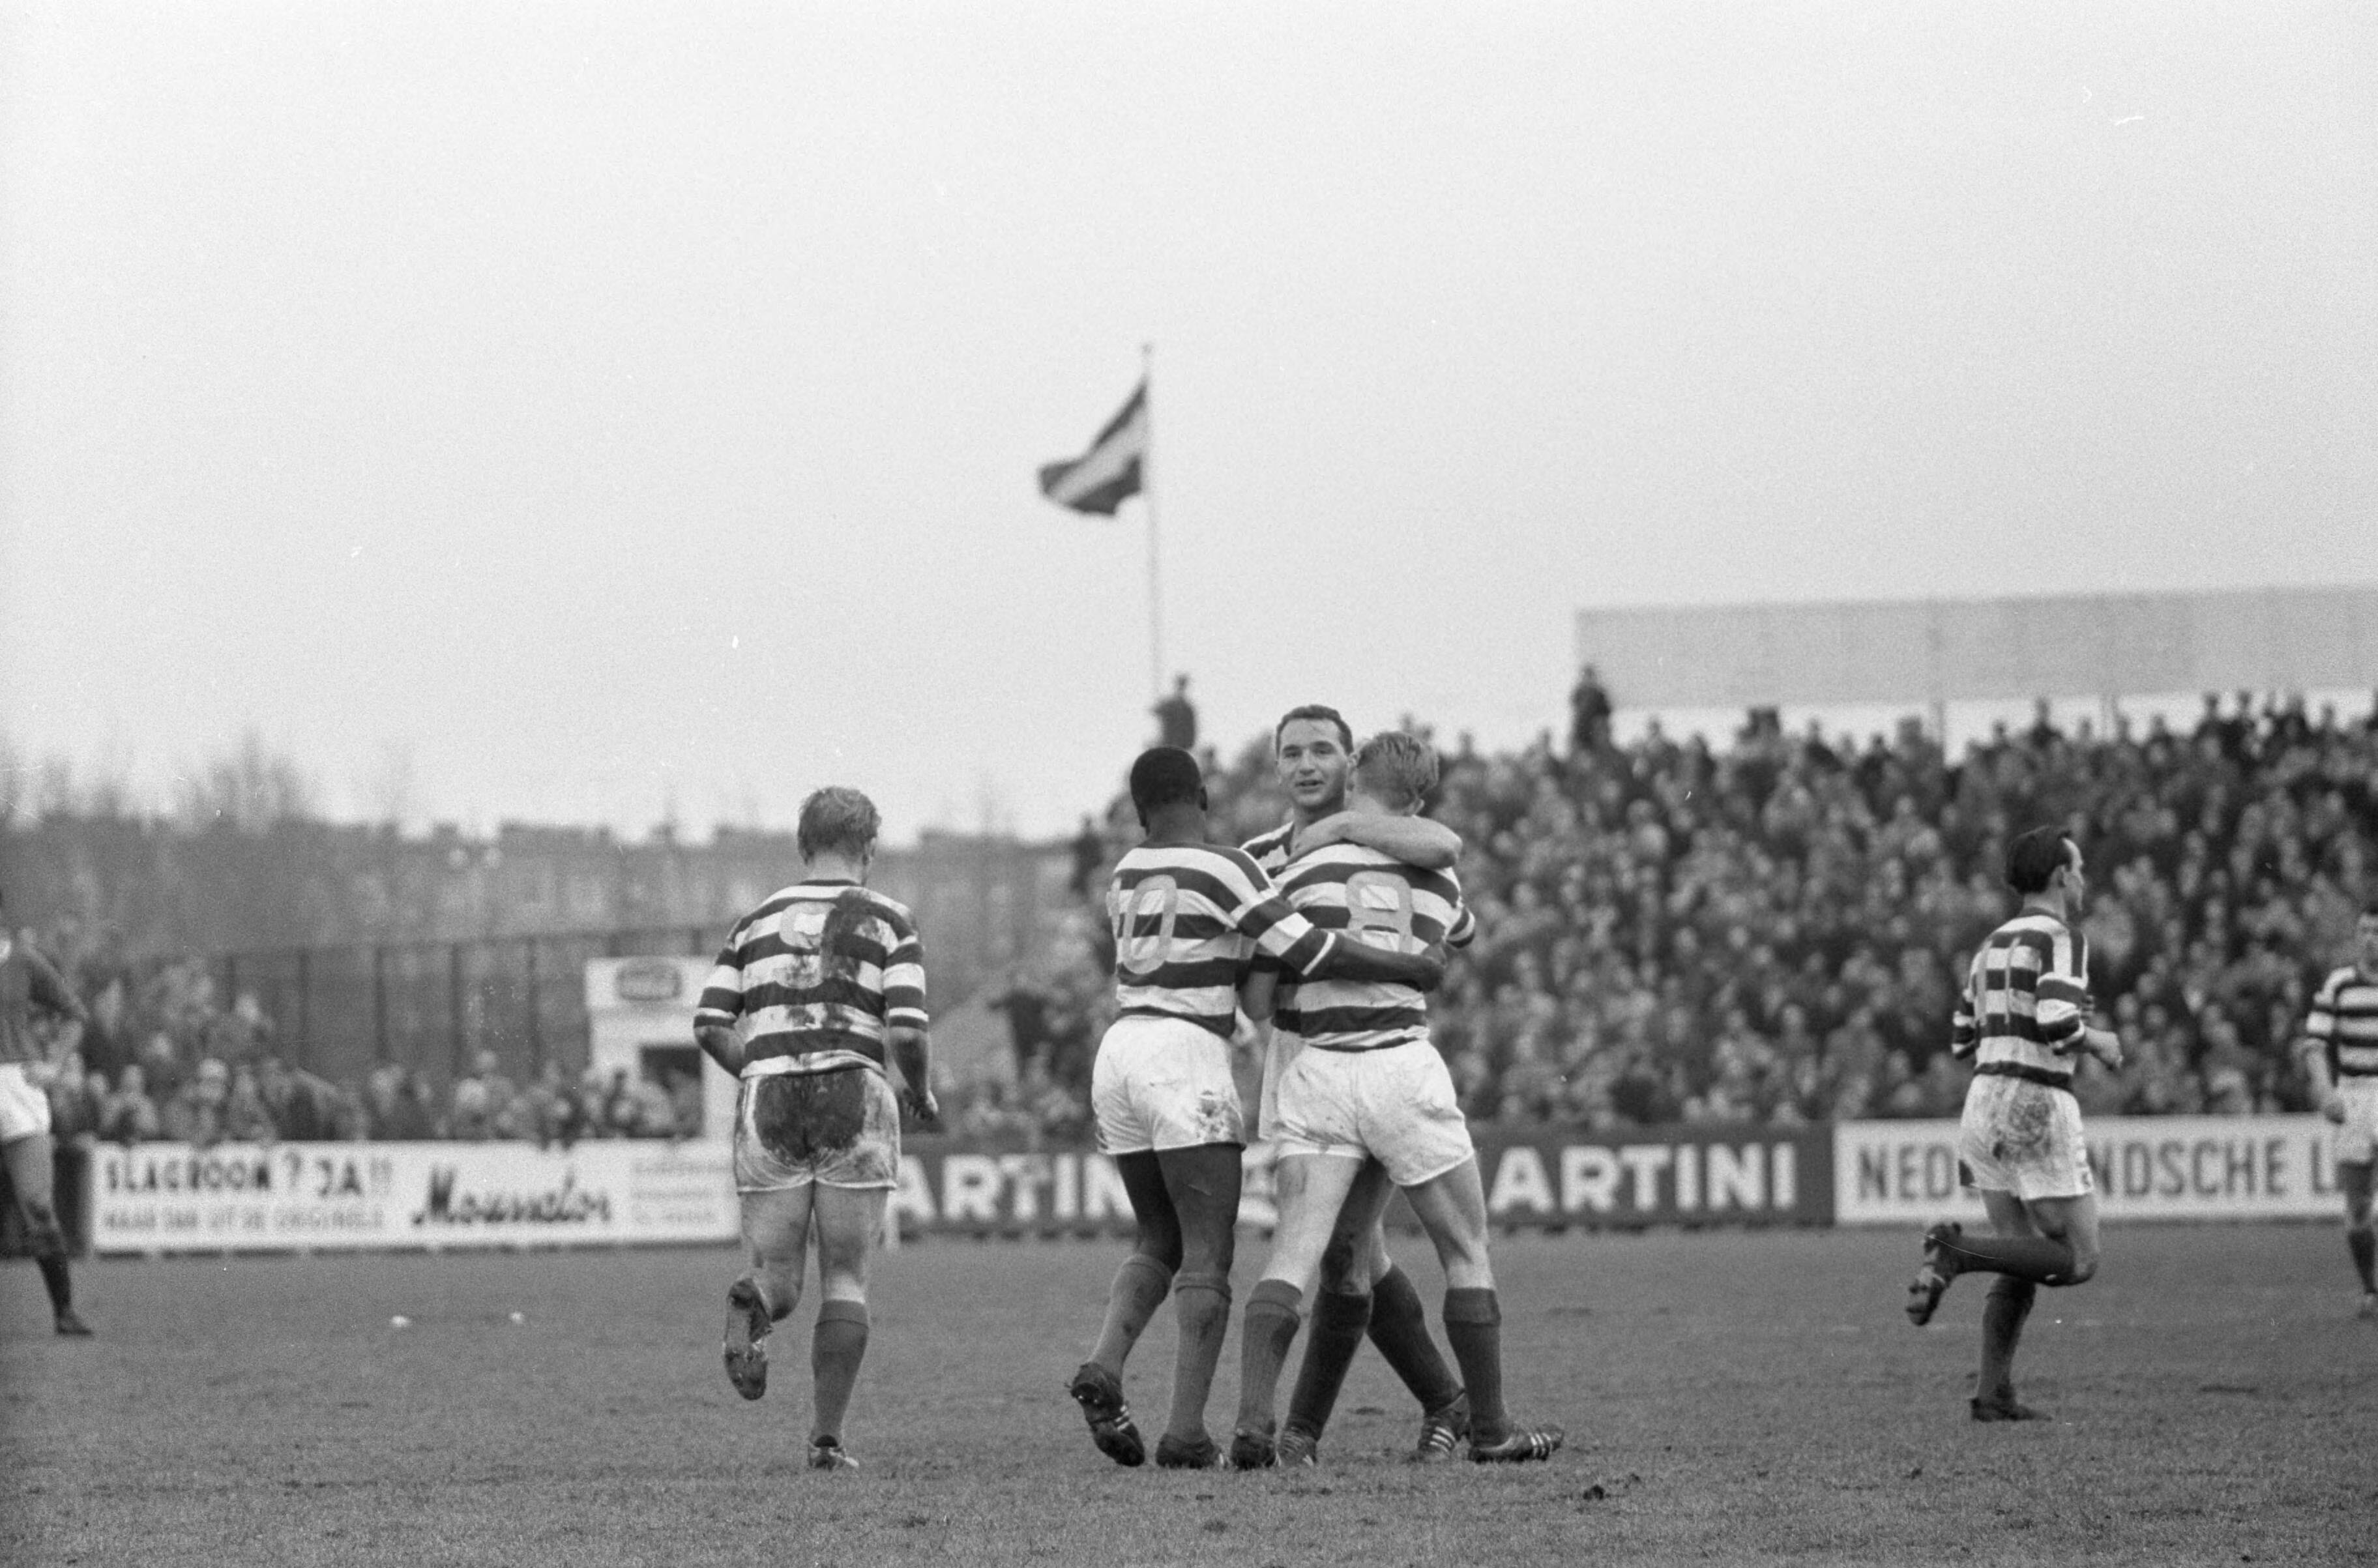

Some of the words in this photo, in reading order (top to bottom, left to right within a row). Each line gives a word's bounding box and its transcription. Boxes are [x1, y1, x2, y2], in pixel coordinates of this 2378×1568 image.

[885, 1154, 1137, 1221] ARTIN
[1489, 1142, 1797, 1215] ARTINI
[1858, 1138, 2288, 1200] NEDNDSCHE
